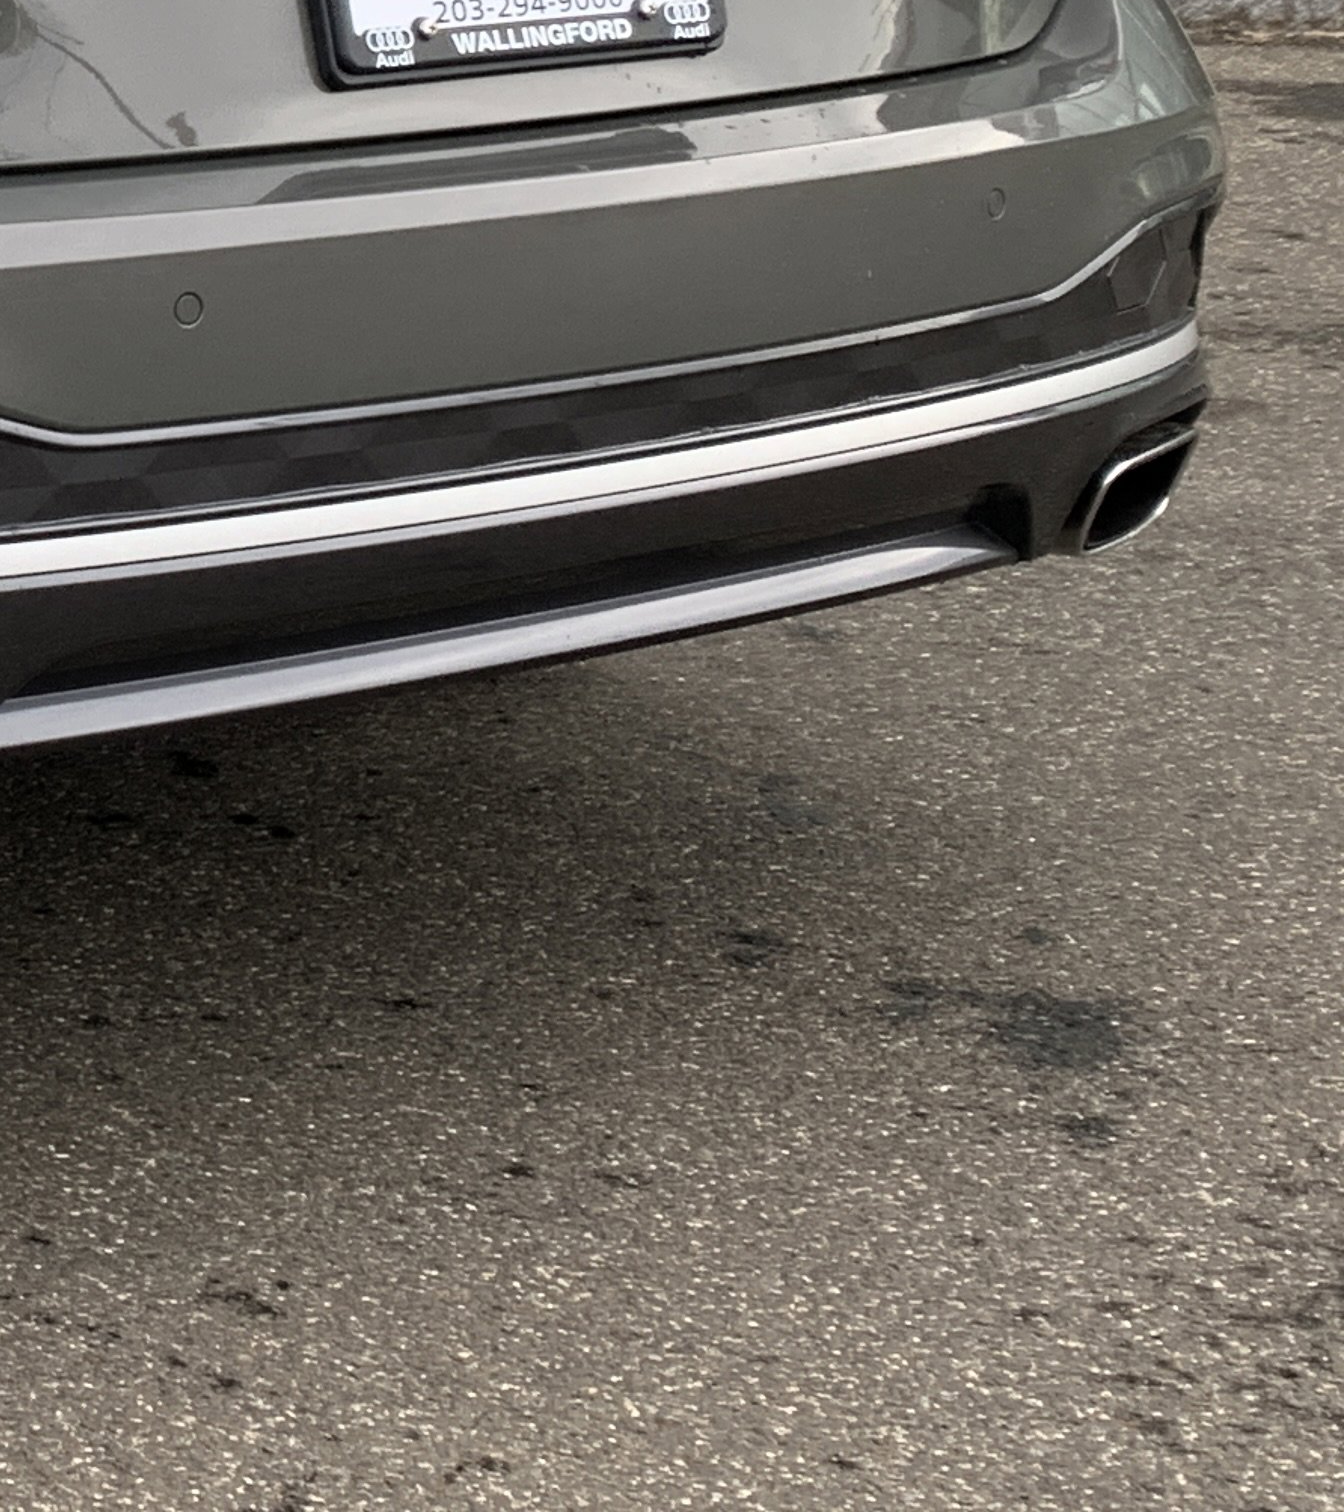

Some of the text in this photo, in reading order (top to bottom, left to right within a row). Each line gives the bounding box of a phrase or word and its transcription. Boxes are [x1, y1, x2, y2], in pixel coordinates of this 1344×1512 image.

[451, 17, 633, 56] WALLINGFORD
[673, 22, 711, 41] Audi
[375, 49, 416, 69] Audi
